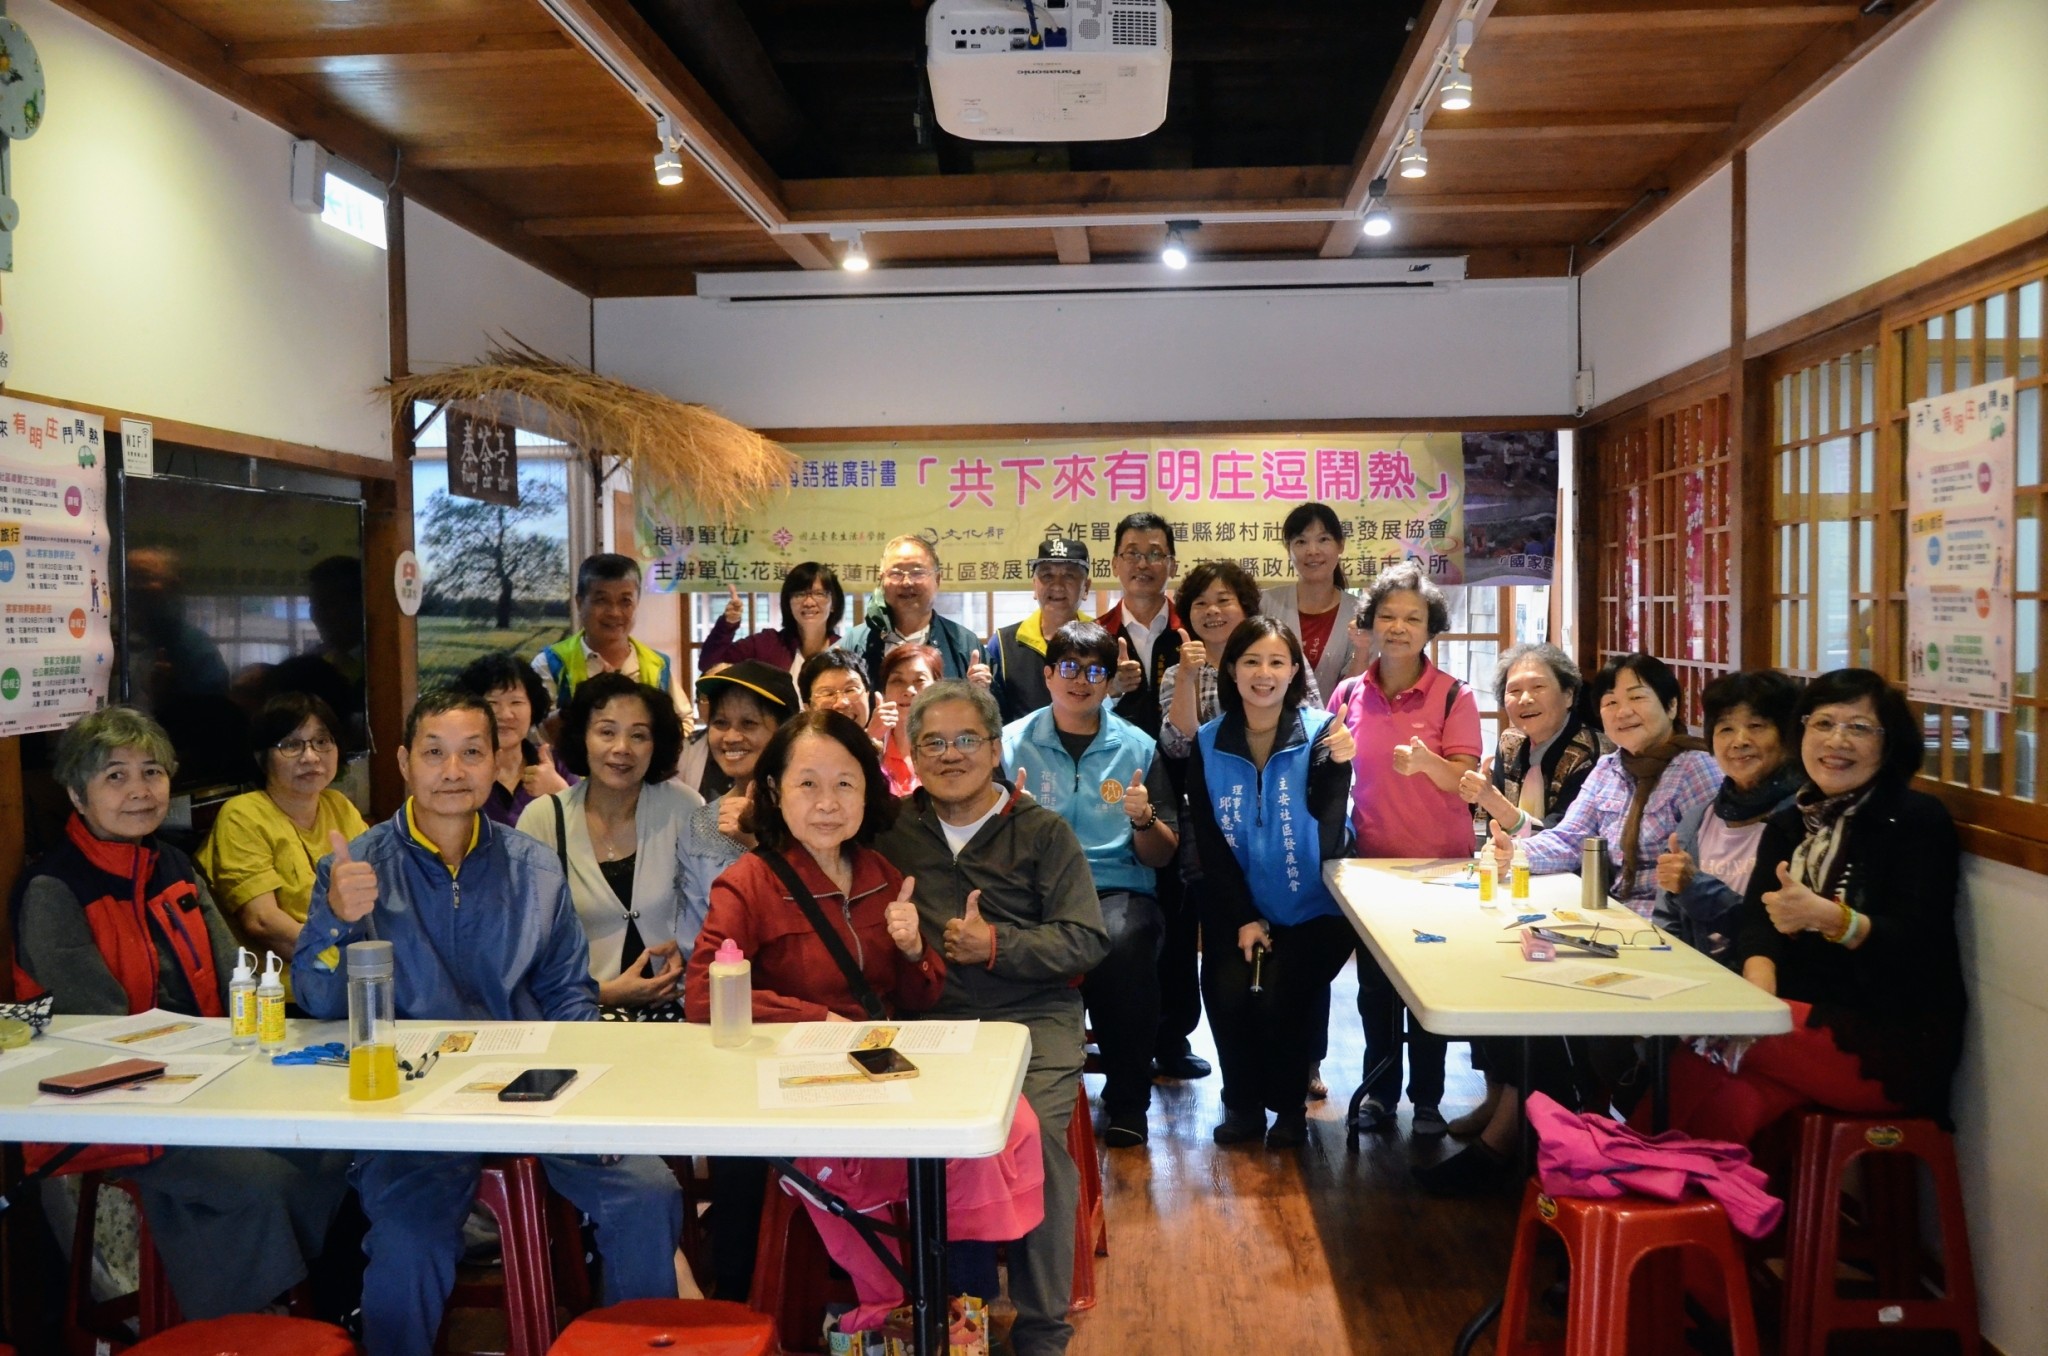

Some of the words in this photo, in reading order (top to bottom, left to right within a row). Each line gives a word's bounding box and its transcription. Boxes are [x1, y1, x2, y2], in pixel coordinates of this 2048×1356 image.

[918, 449, 1448, 508] 「共下來有明庄逗鬧熱」
[941, 526, 1005, 540] 文化部
[1231, 784, 1244, 823] 理事長
[1277, 777, 1301, 892] 主安社區發展協會
